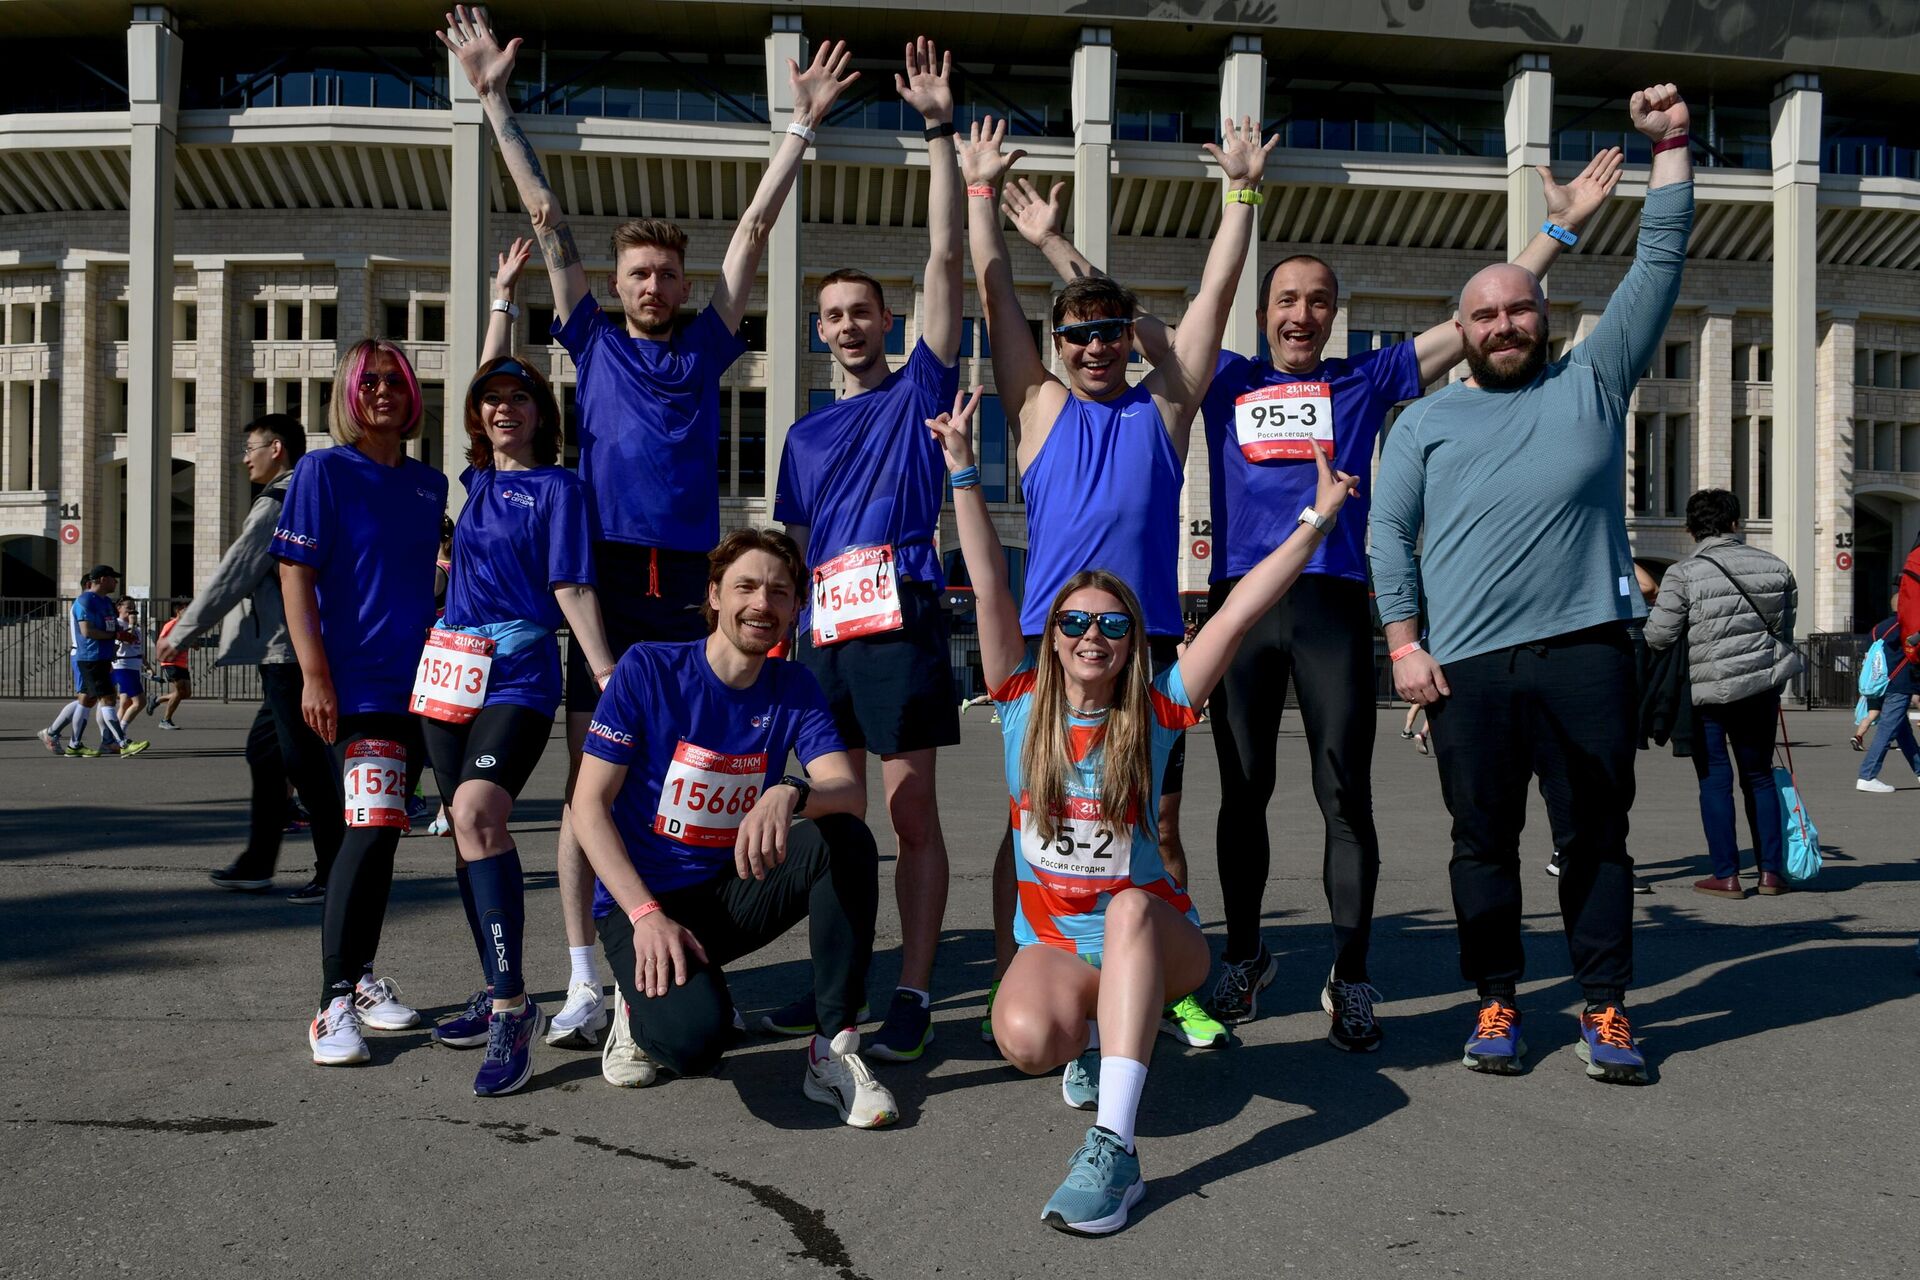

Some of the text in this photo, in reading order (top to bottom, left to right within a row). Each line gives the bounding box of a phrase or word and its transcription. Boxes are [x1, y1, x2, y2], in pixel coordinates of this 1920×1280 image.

[1251, 403, 1317, 428] 95-3
[60, 503, 81, 520] 11
[1190, 520, 1211, 536] 12
[1836, 533, 1853, 549] 13
[423, 657, 483, 694] 15213
[417, 695, 426, 708] F
[671, 777, 758, 815] 15668
[357, 808, 365, 822] E
[668, 819, 681, 834] D
[1040, 857, 1106, 873] Россия сегодня
[491, 923, 509, 972] SKINS
